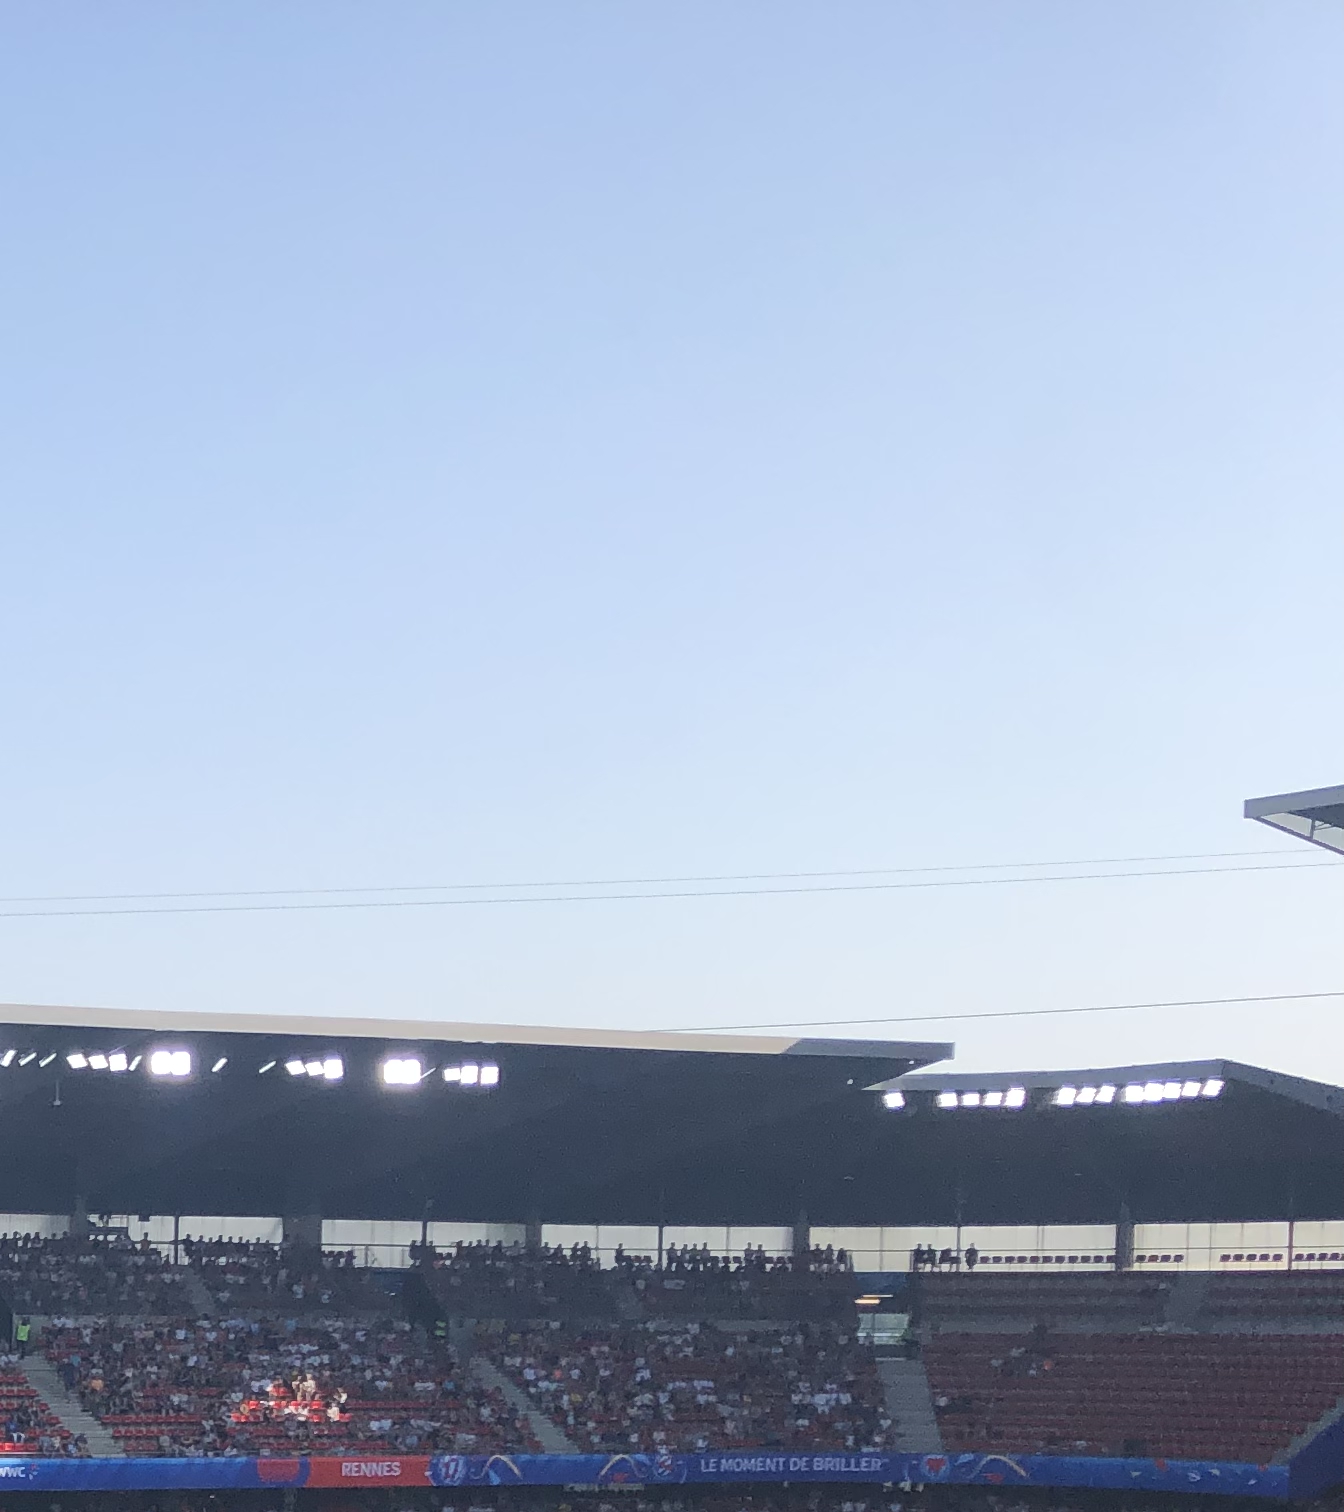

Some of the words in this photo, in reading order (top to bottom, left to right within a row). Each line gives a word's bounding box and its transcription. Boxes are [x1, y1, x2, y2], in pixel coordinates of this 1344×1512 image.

[341, 1462, 401, 1477] RENNES
[701, 1458, 717, 1472] LE
[720, 1457, 786, 1472] MOMENT
[789, 1457, 810, 1472] DE
